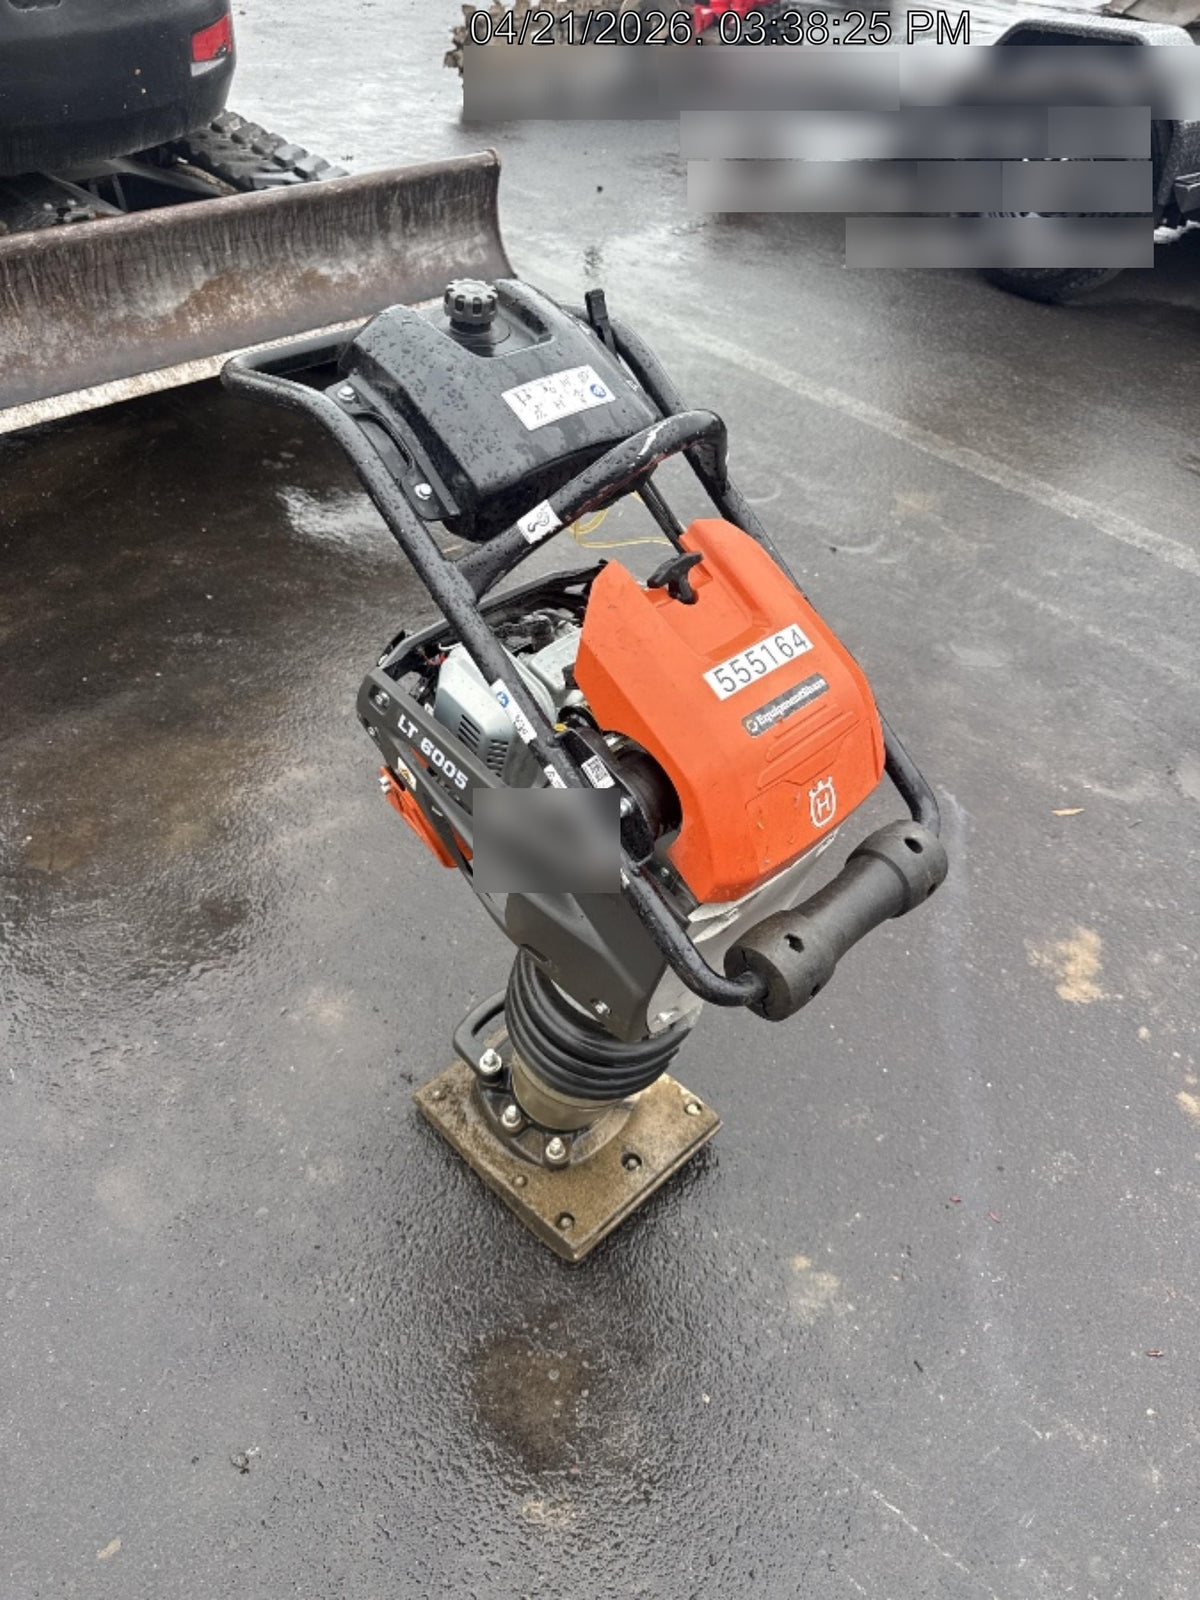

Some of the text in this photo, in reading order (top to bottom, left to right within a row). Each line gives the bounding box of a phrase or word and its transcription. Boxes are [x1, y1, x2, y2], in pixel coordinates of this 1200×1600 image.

[712, 629, 808, 693] 555164
[397, 714, 468, 790] LT 6005
